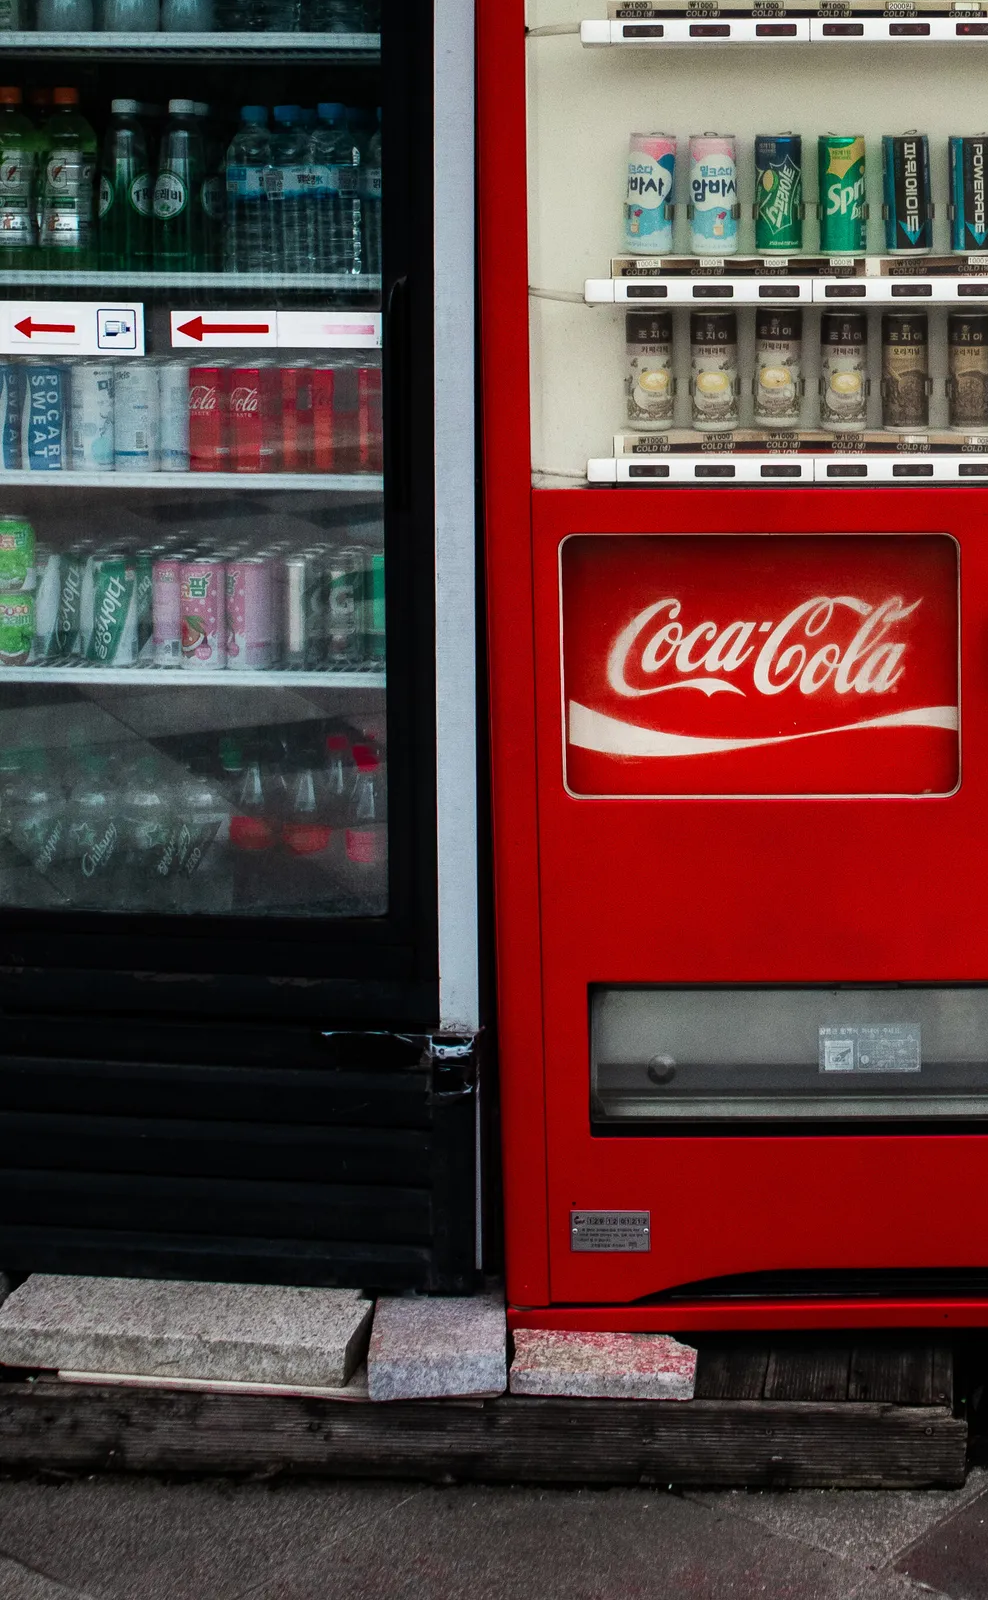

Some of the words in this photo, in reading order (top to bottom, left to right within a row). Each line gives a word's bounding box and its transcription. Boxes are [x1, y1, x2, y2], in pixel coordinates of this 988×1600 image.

[628, 164, 653, 175] 크소다
[700, 165, 733, 178] 밀크소다
[628, 176, 664, 198] 바사
[903, 142, 919, 232] 파워에이드
[972, 143, 986, 233] POWERADE
[32, 375, 48, 458] SWEAT
[46, 374, 60, 468] POCARI
[636, 444, 658, 452] COLD
[701, 442, 723, 450] COLD
[766, 441, 788, 449] COLD
[832, 442, 853, 450] COLD
[896, 443, 918, 451] COLD
[606, 596, 924, 698] Coca-Cola
